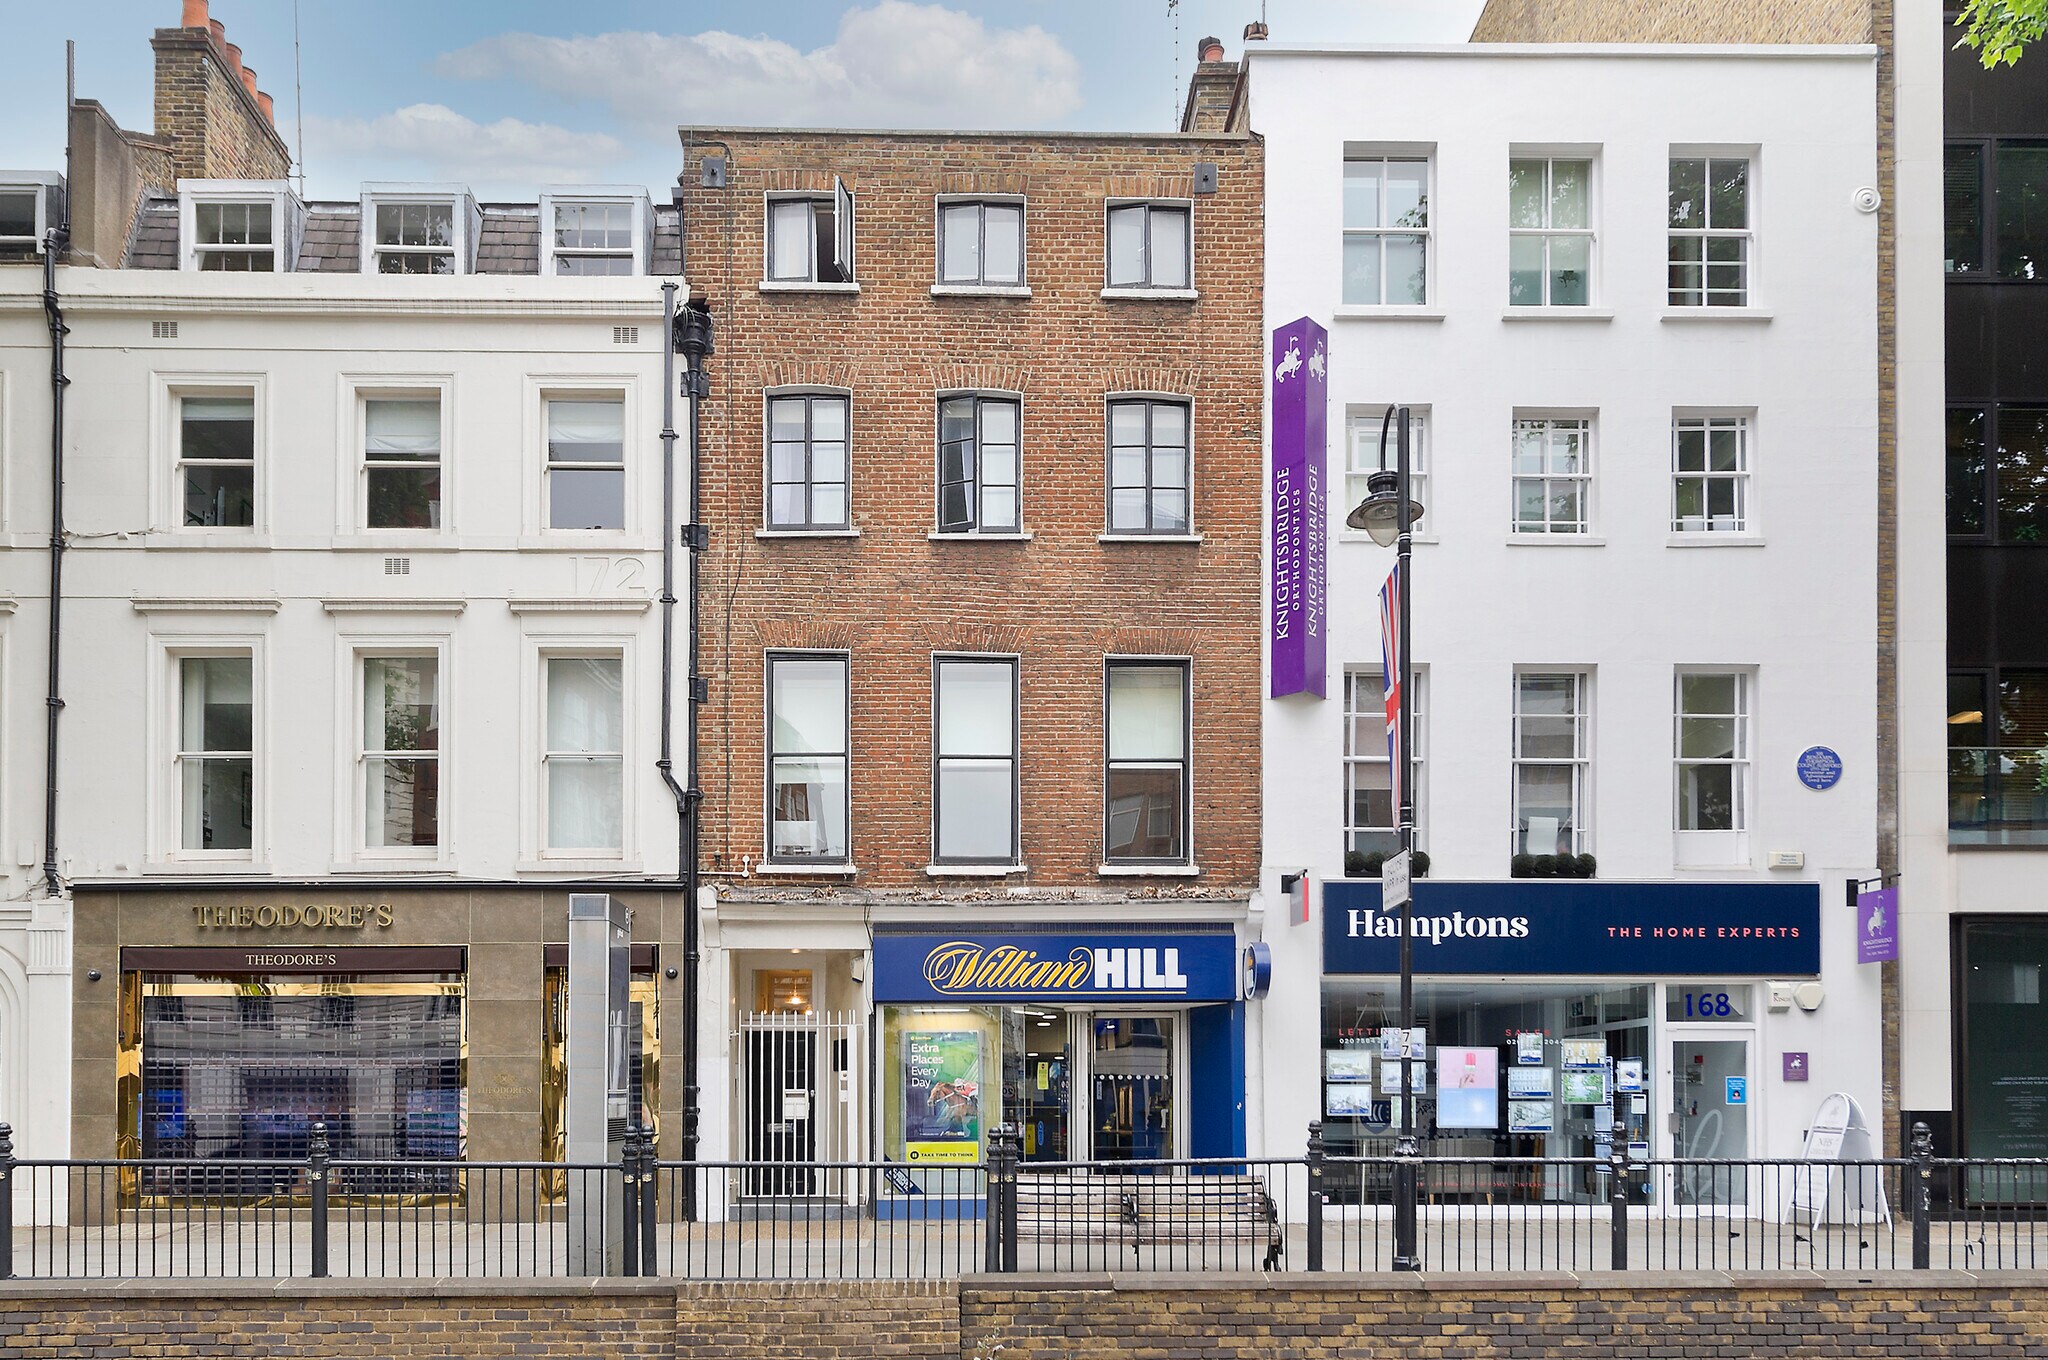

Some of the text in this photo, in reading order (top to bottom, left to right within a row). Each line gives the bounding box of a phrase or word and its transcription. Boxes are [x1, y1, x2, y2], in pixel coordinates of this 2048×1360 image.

[1276, 467, 1290, 640] KNIGHTSBRIDGE
[1292, 489, 1300, 611] ORTHODONTICS
[1308, 464, 1318, 637] KNIGHTSBRIDGE
[568, 556, 645, 595] 172
[192, 903, 395, 928] THEODORE'S
[1346, 909, 1530, 946] Hamptons
[1607, 927, 1800, 938] THE HOME EXPERTS
[246, 954, 337, 966] THEODORE'S
[922, 941, 1187, 992] William HILL
[1685, 993, 1731, 1017] 168
[1338, 1028, 1400, 1036] LETTING
[1402, 1032, 1410, 1042] 7
[911, 1043, 939, 1053] Extra
[1401, 1045, 1409, 1055] 7
[911, 1054, 944, 1064] Places
[911, 1066, 939, 1077] Every
[911, 1077, 931, 1089] Day
